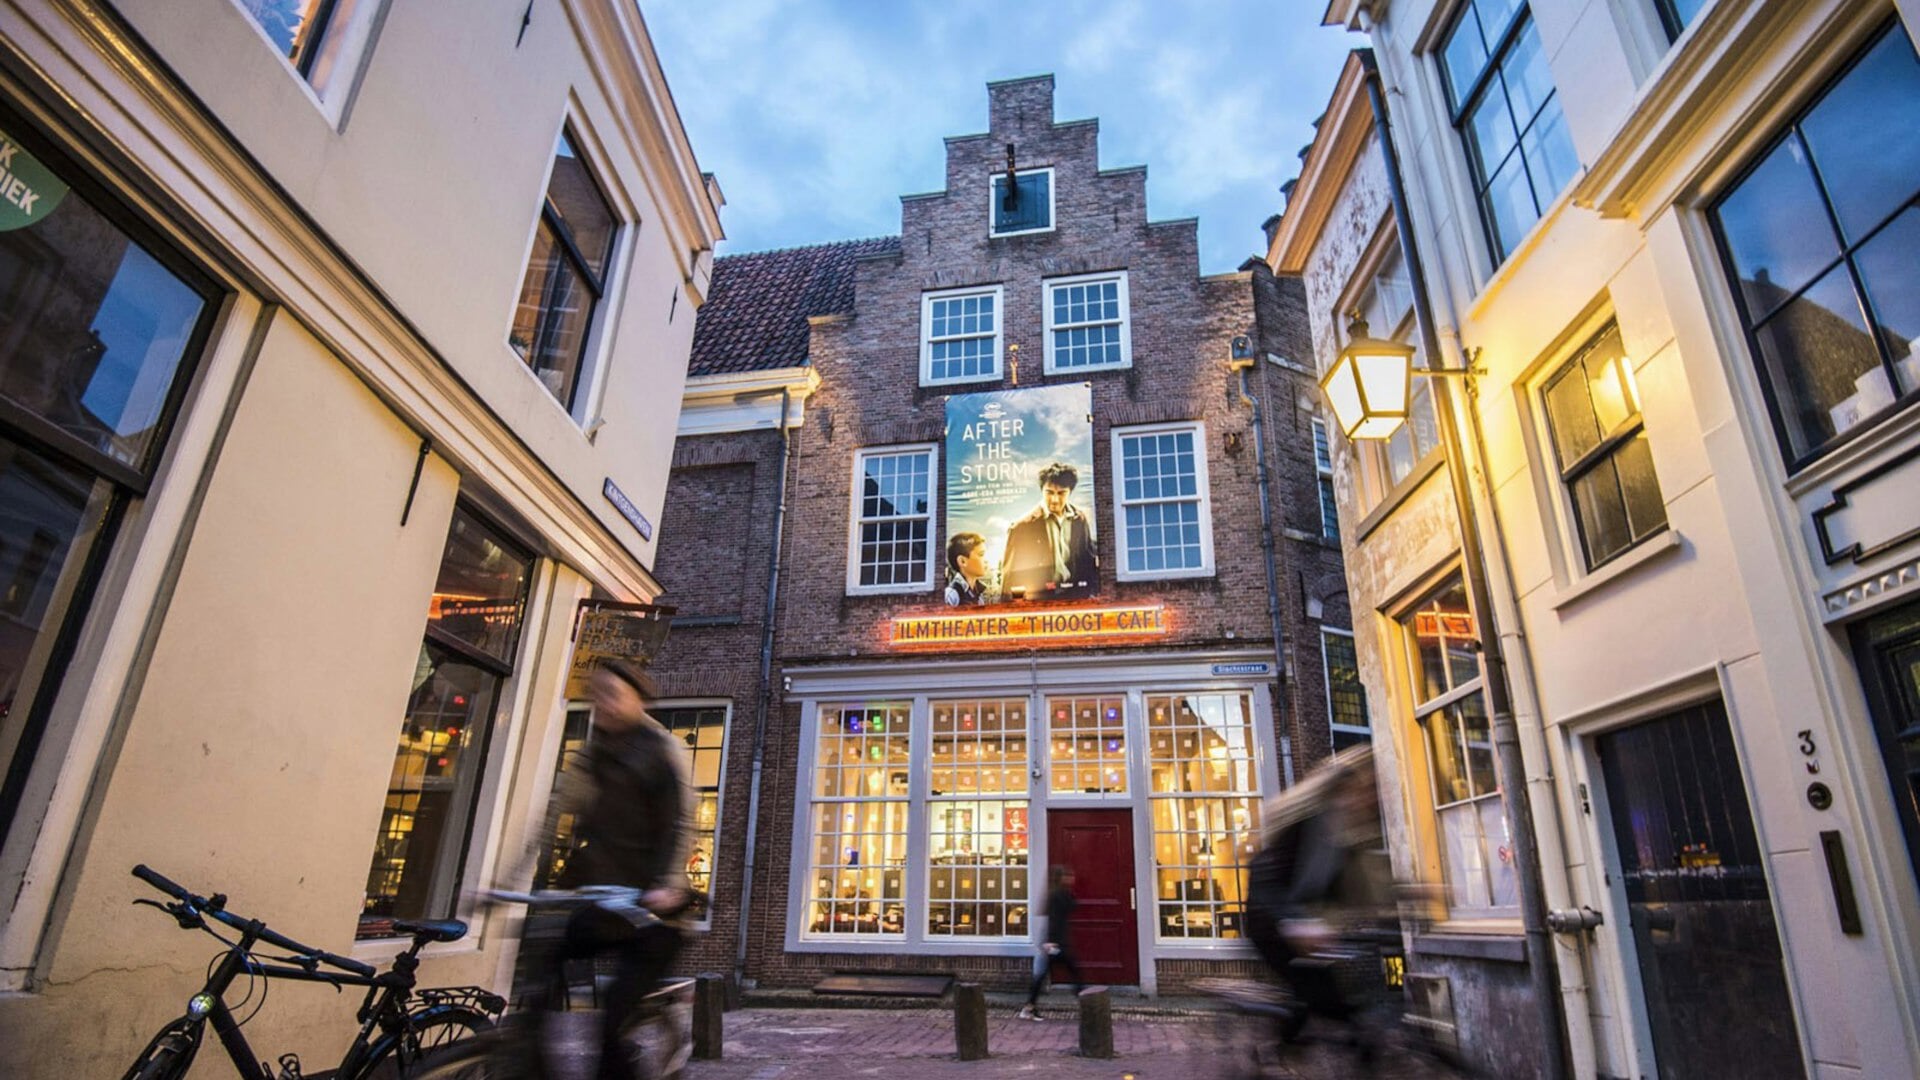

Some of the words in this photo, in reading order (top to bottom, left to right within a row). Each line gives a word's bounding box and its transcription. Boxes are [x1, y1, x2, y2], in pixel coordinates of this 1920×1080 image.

[962, 418, 1025, 441] AFTER
[976, 441, 1012, 460] THE
[961, 461, 1029, 484] STORM
[1798, 729, 1817, 756] 3
